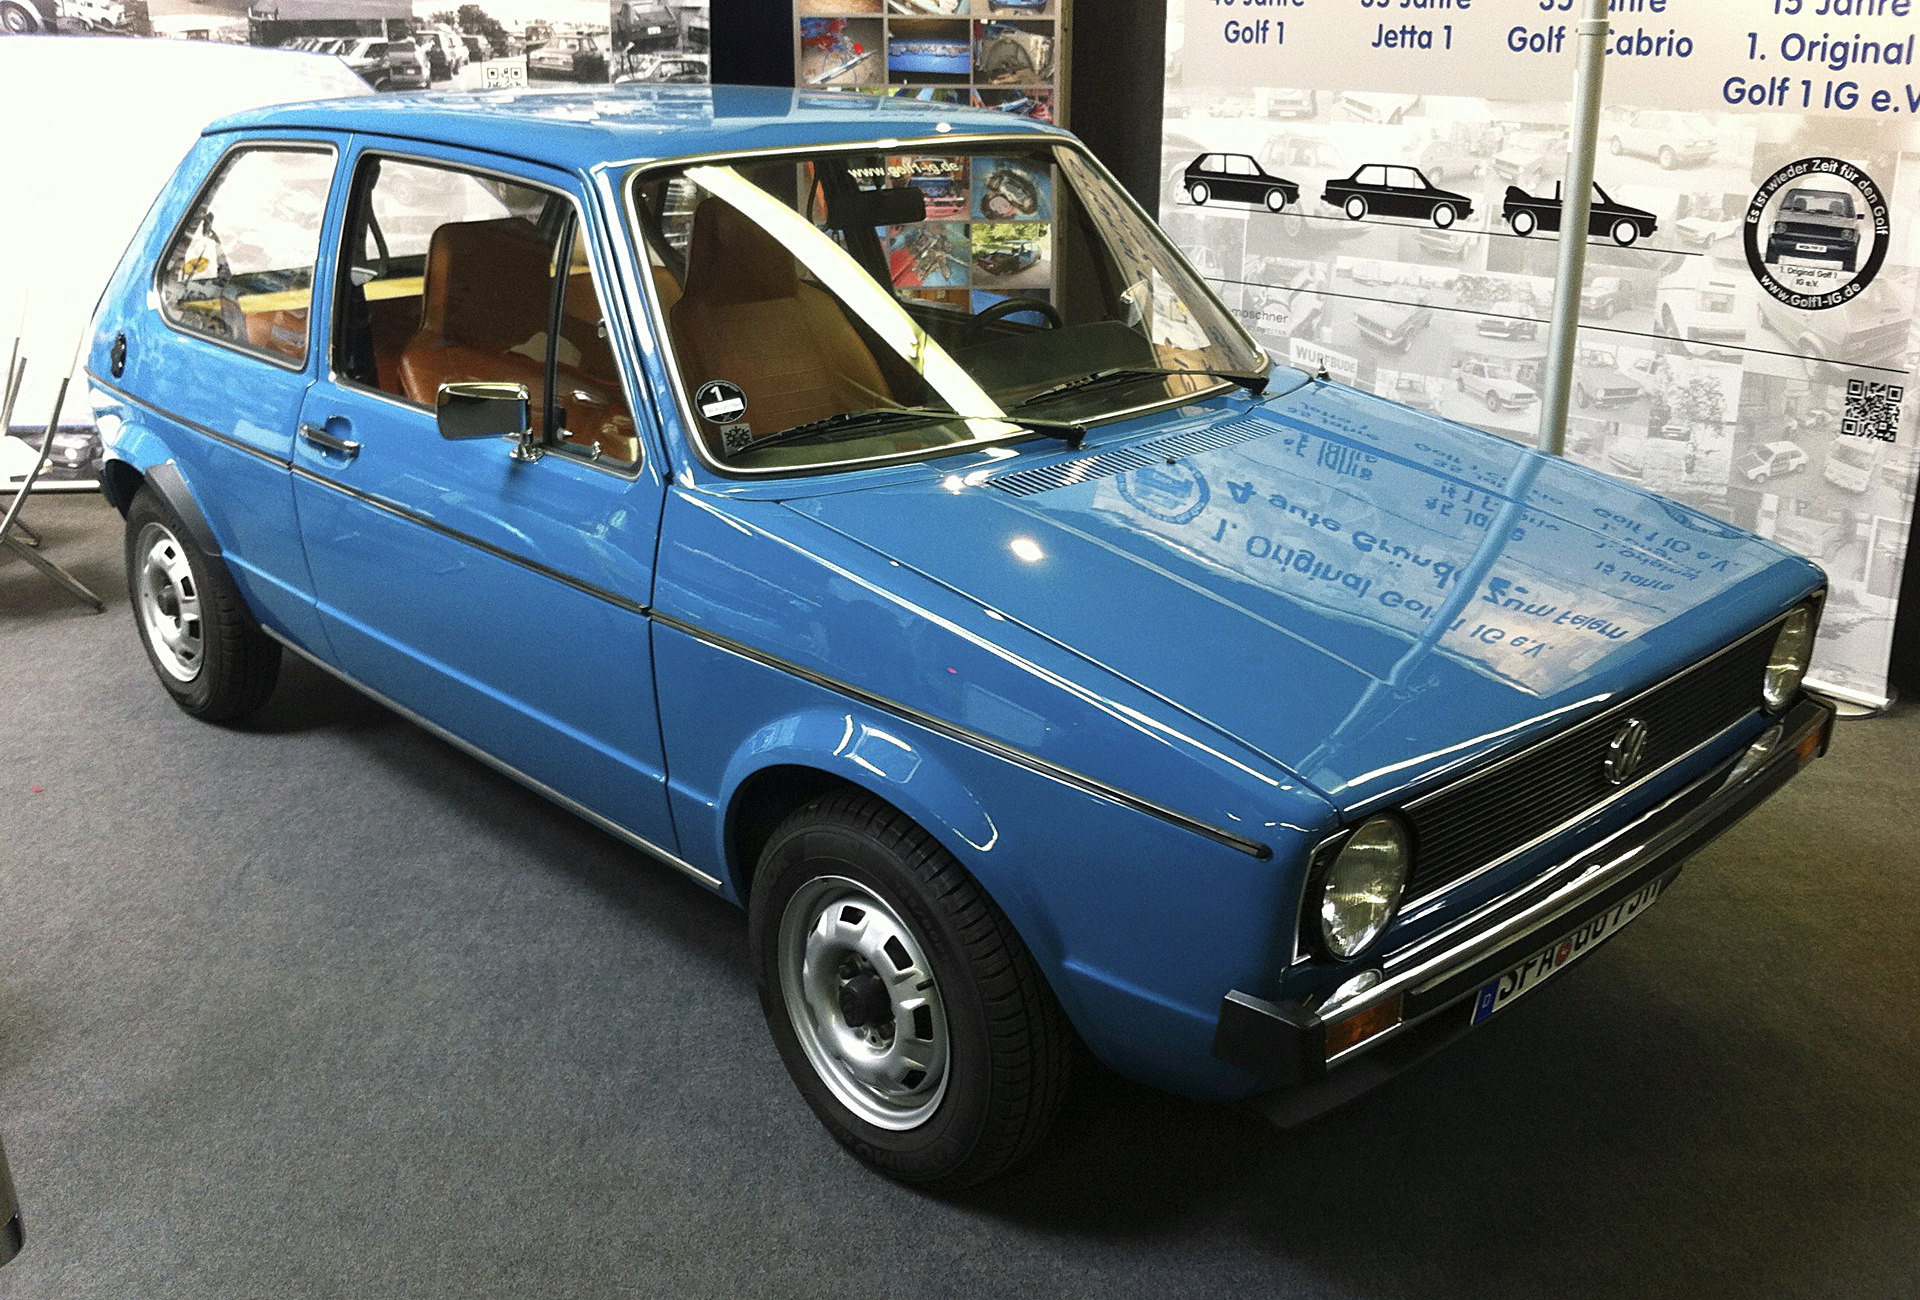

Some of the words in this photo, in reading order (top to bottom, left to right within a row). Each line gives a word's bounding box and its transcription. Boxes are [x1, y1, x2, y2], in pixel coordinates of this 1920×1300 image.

[1223, 20, 1268, 44] Golf
[1277, 21, 1285, 45] 1
[1371, 24, 1432, 49] Jetta
[1442, 25, 1452, 50] 1
[1507, 26, 1566, 53] Golf
[1747, 32, 1766, 60] 1.
[1780, 33, 1915, 71] Original
[1722, 76, 1790, 106] Golf
[1800, 80, 1811, 107] 1
[1823, 81, 1858, 110] IG
[1746, 212, 1760, 224] Es
[1755, 191, 1768, 208] ist
[1767, 162, 1808, 192] wieder
[1812, 159, 1839, 173] Zeit
[1840, 164, 1859, 182] für
[1858, 180, 1878, 204] den
[1873, 205, 1889, 236] Golf
[1787, 266, 1815, 279] Original
[1817, 270, 1832, 280] Golf
[1760, 274, 1862, 308] www.Golf1-IG.de
[1295, 344, 1357, 374] WURFBUDE
[710, 386, 724, 402] 1
